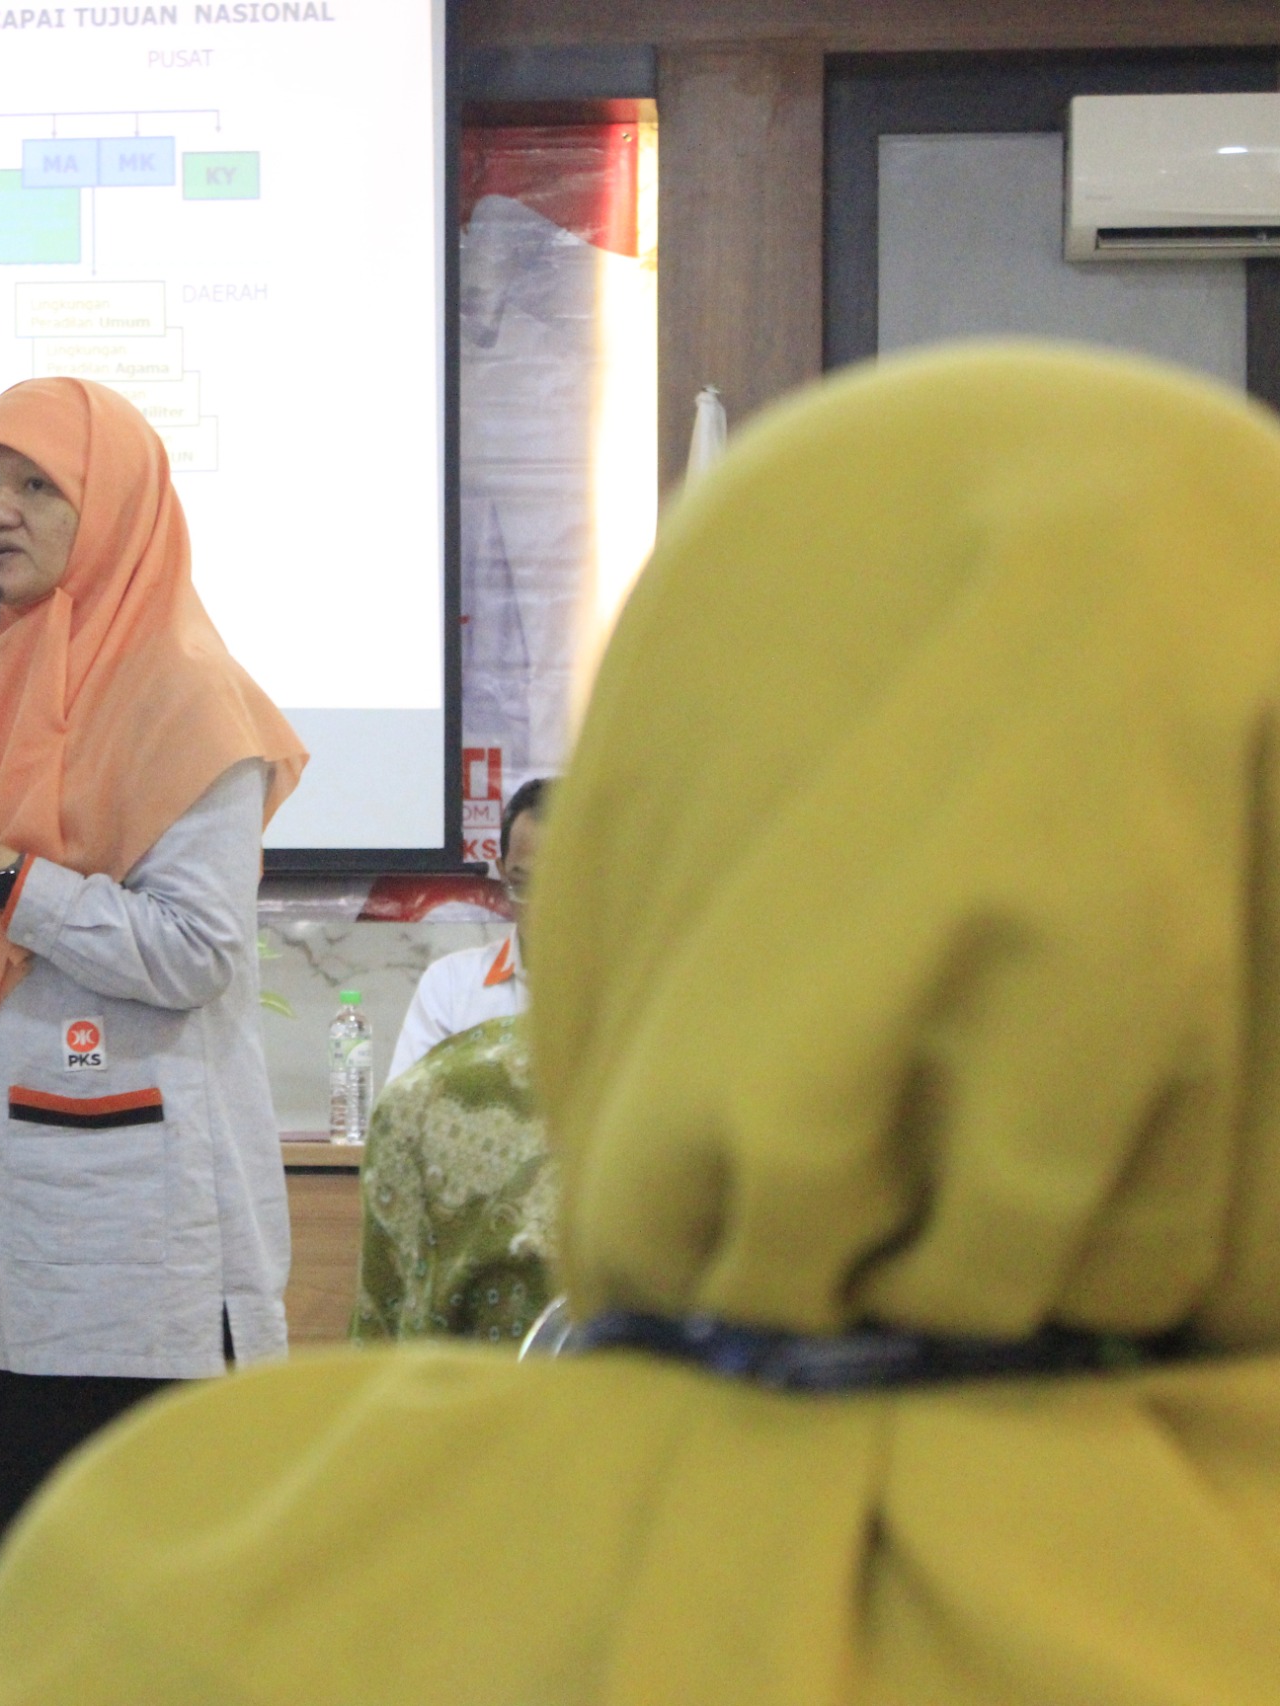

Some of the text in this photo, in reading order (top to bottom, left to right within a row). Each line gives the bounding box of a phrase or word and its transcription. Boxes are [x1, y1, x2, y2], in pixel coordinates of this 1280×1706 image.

[74, 5, 177, 27] TUJUAN
[195, 1, 336, 24] NASIONAL
[147, 49, 214, 68] PUSAT
[42, 154, 79, 173] MA
[119, 153, 156, 172] MK
[206, 167, 237, 185] KY
[182, 284, 268, 303] DAERAH
[100, 317, 151, 328] Umum
[116, 363, 170, 377] Agama
[68, 1053, 101, 1067] PKS
